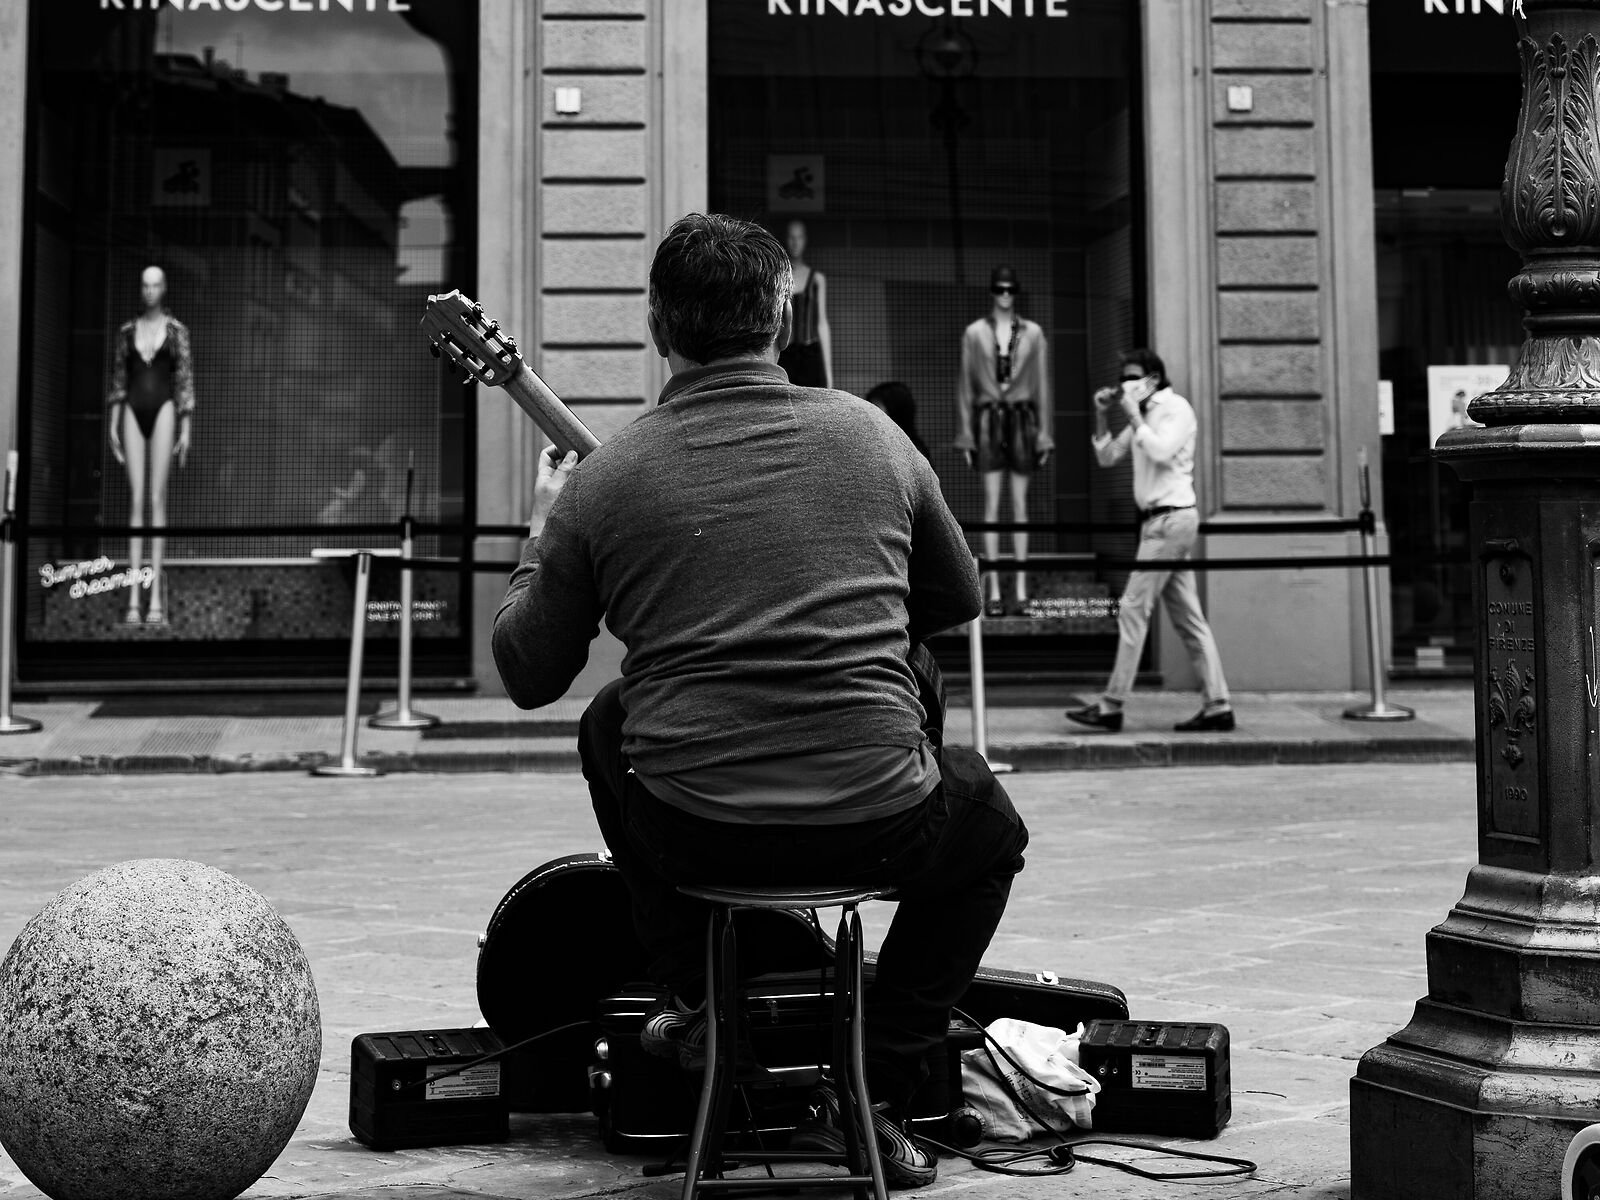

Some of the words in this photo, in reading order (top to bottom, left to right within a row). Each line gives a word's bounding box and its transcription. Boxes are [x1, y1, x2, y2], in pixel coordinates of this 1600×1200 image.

[1489, 601, 1533, 616] COMUNE
[1504, 619, 1515, 634] DI
[1489, 637, 1535, 652] FIRENZE
